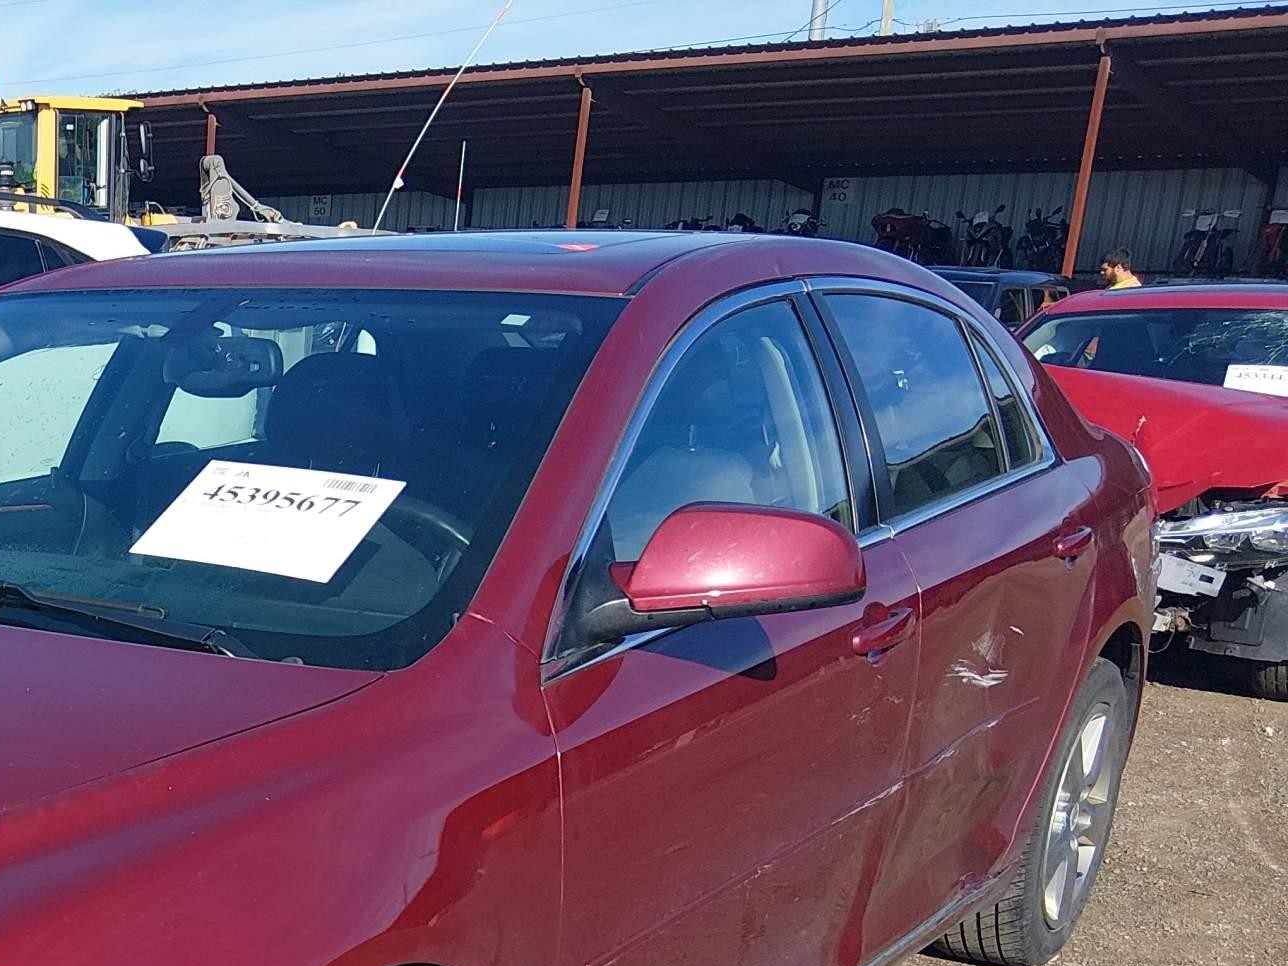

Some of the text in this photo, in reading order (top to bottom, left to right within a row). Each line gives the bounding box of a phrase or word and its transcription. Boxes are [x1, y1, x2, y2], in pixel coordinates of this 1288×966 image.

[313, 196, 328, 205] MC
[314, 207, 326, 216] 50
[203, 483, 363, 517] 45395677
